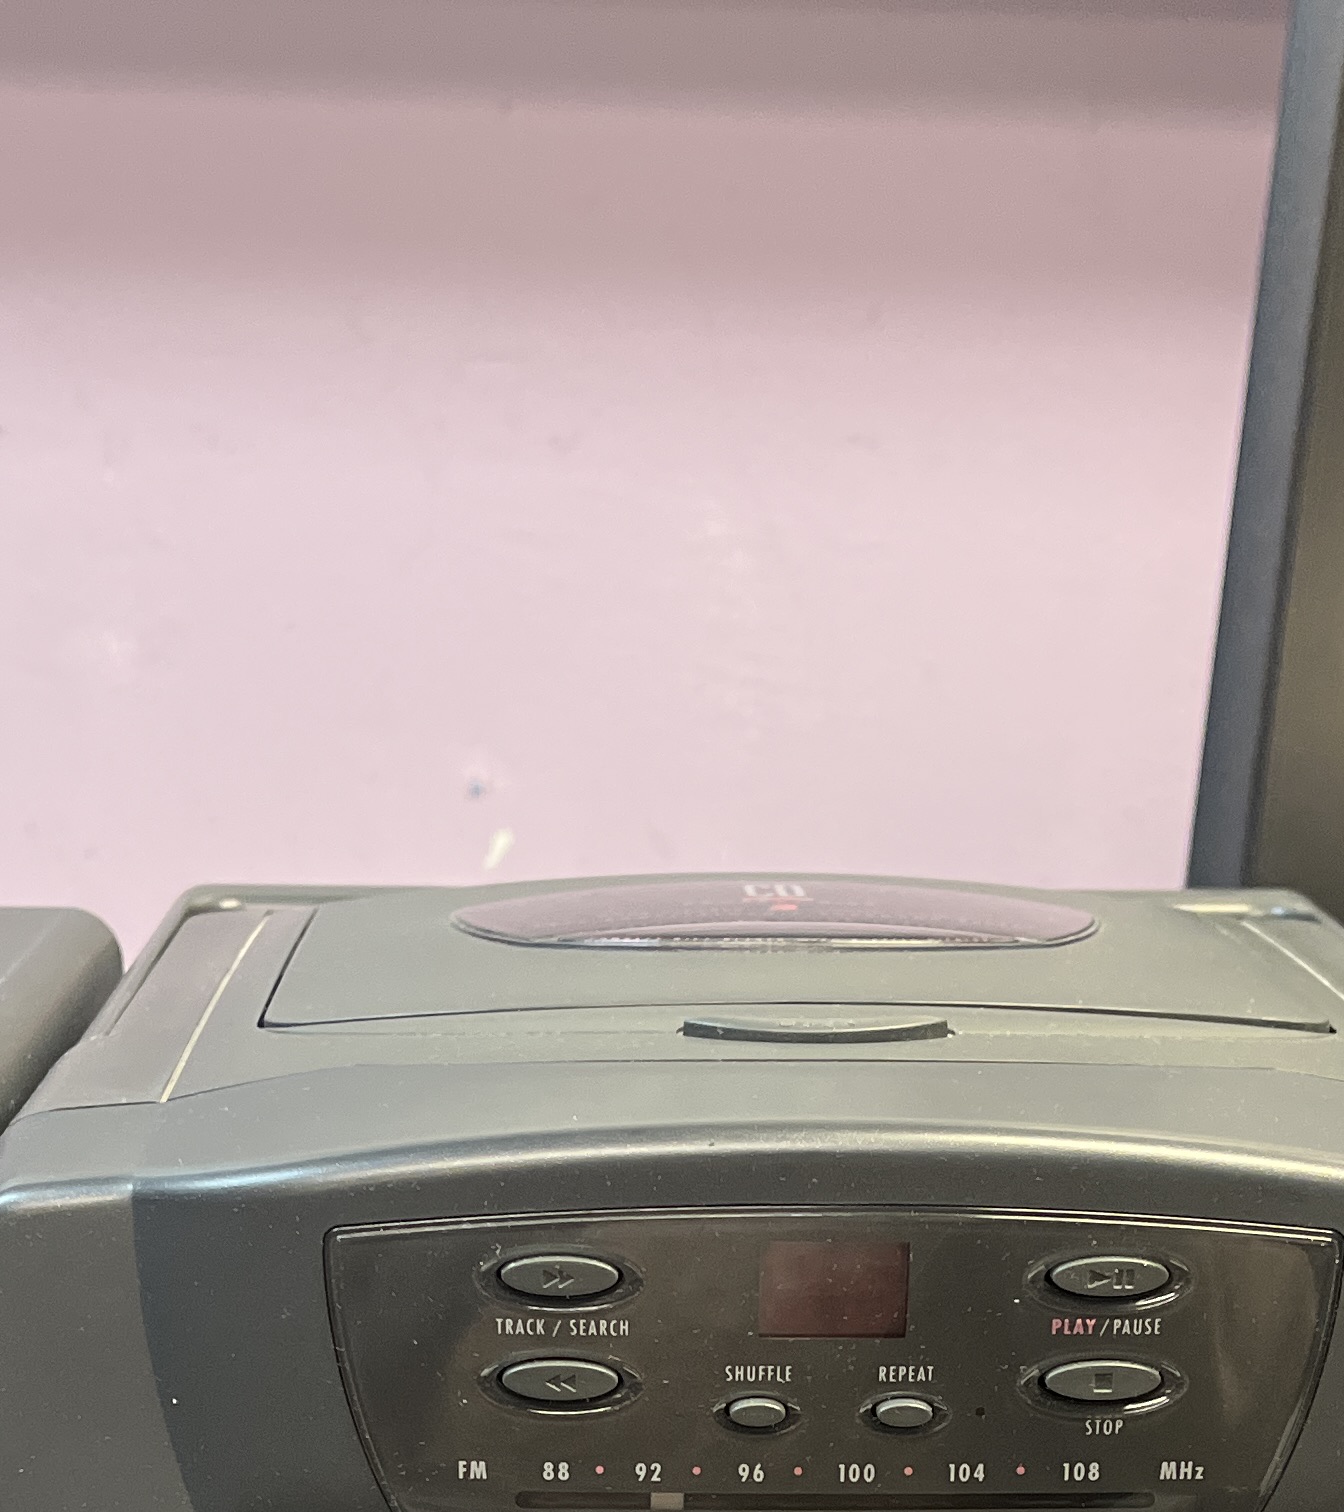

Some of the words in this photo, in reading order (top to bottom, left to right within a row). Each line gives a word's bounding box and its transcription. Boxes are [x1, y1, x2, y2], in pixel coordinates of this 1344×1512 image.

[495, 1317, 545, 1336] TRACK
[568, 1317, 629, 1337] SEARCH
[724, 1365, 792, 1384] SHUFFLE
[878, 1365, 934, 1383] REPEAT
[1085, 1418, 1124, 1436] STOP
[458, 1460, 488, 1480] FM
[542, 1461, 570, 1481] 88
[635, 1462, 662, 1482] 92
[738, 1463, 765, 1483] 96
[838, 1463, 875, 1483] 100
[948, 1463, 985, 1483] 104
[1062, 1461, 1100, 1482] 108
[1159, 1460, 1204, 1480] MHz
